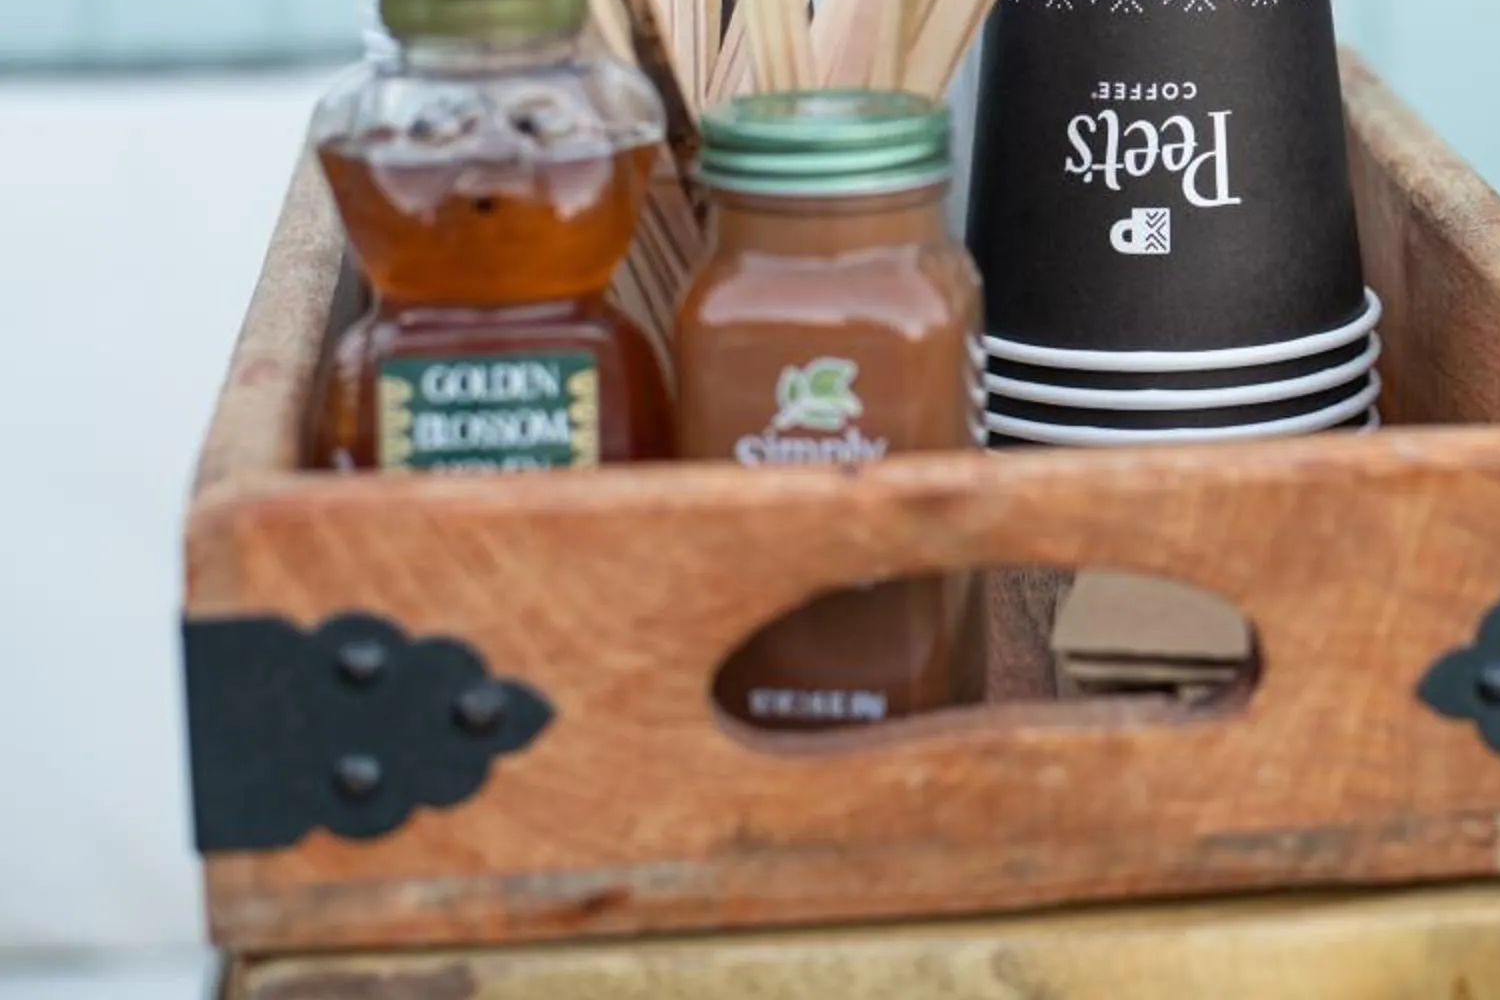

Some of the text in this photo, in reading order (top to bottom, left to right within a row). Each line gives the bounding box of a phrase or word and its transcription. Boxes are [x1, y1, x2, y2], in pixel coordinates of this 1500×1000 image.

[1064, 109, 1242, 208] Peet's
[420, 361, 561, 404] GOLDEN
[412, 407, 570, 451] BLOSSOM
